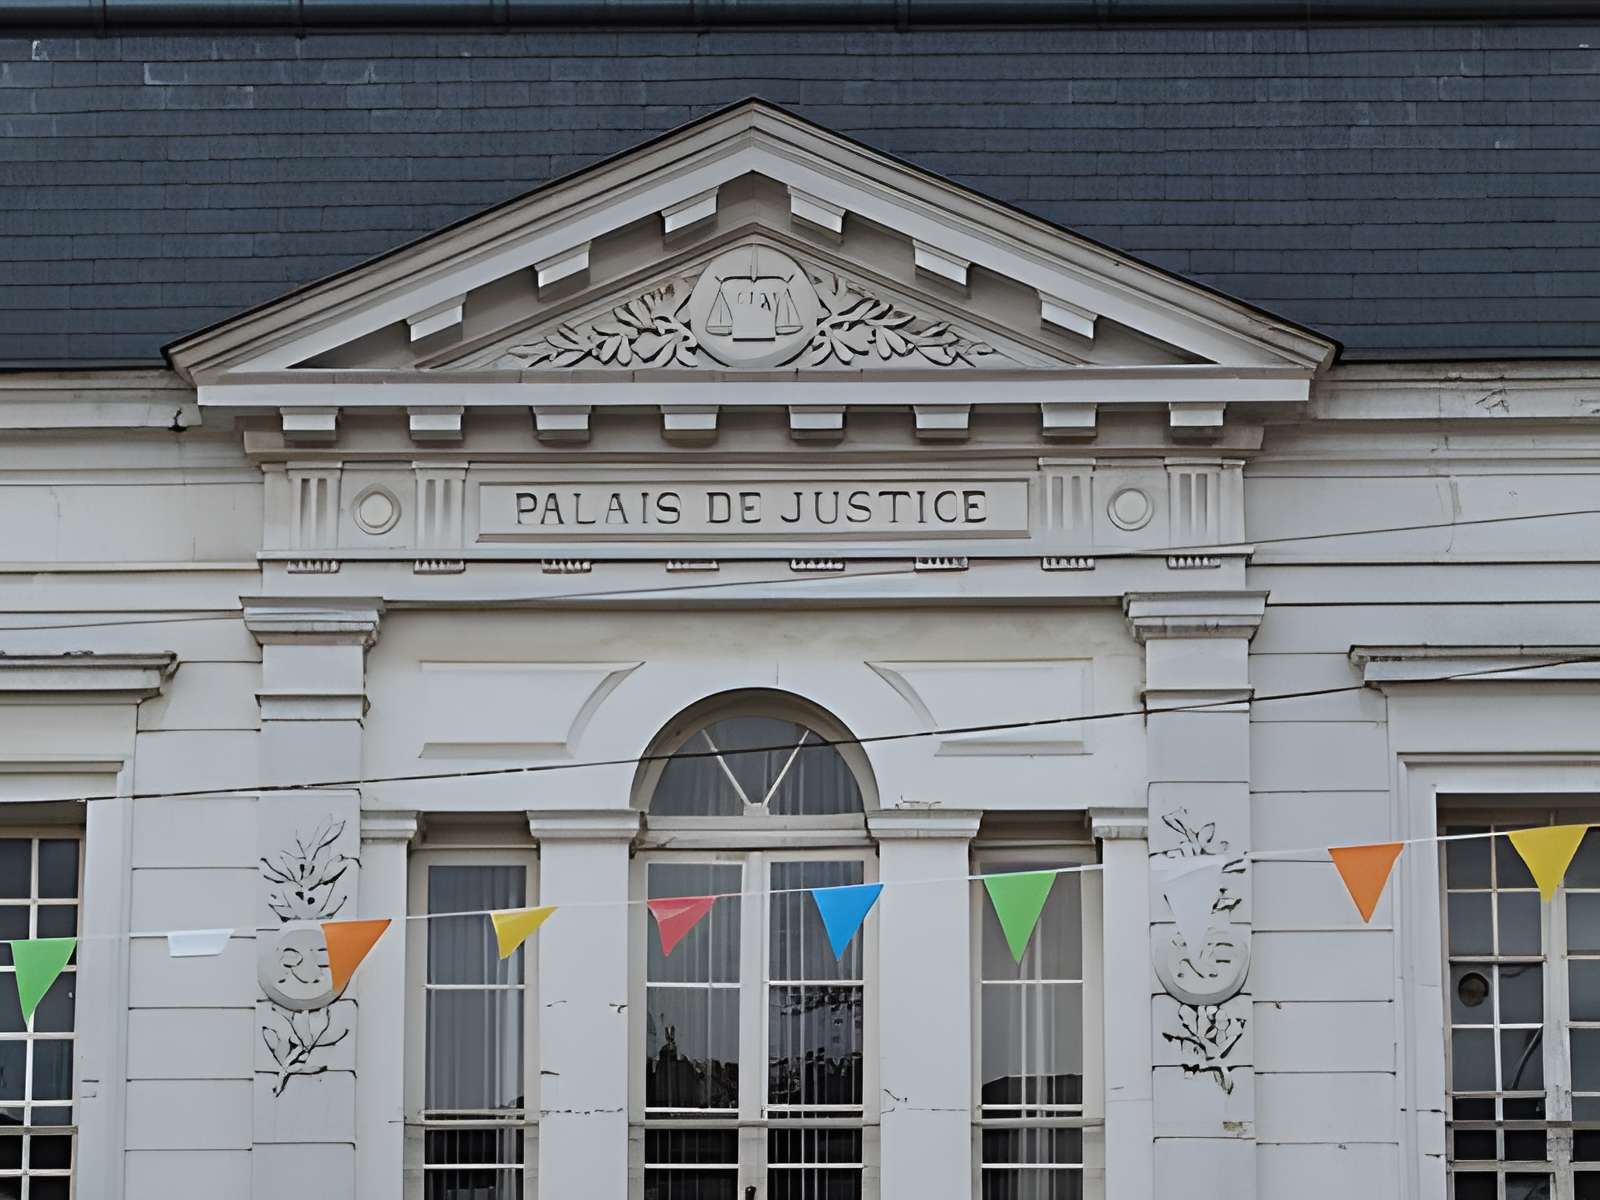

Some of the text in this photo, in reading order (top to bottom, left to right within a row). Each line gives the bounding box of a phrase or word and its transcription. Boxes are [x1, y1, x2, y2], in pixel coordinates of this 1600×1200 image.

[515, 490, 988, 525] PALAIS DE JUSTICE
